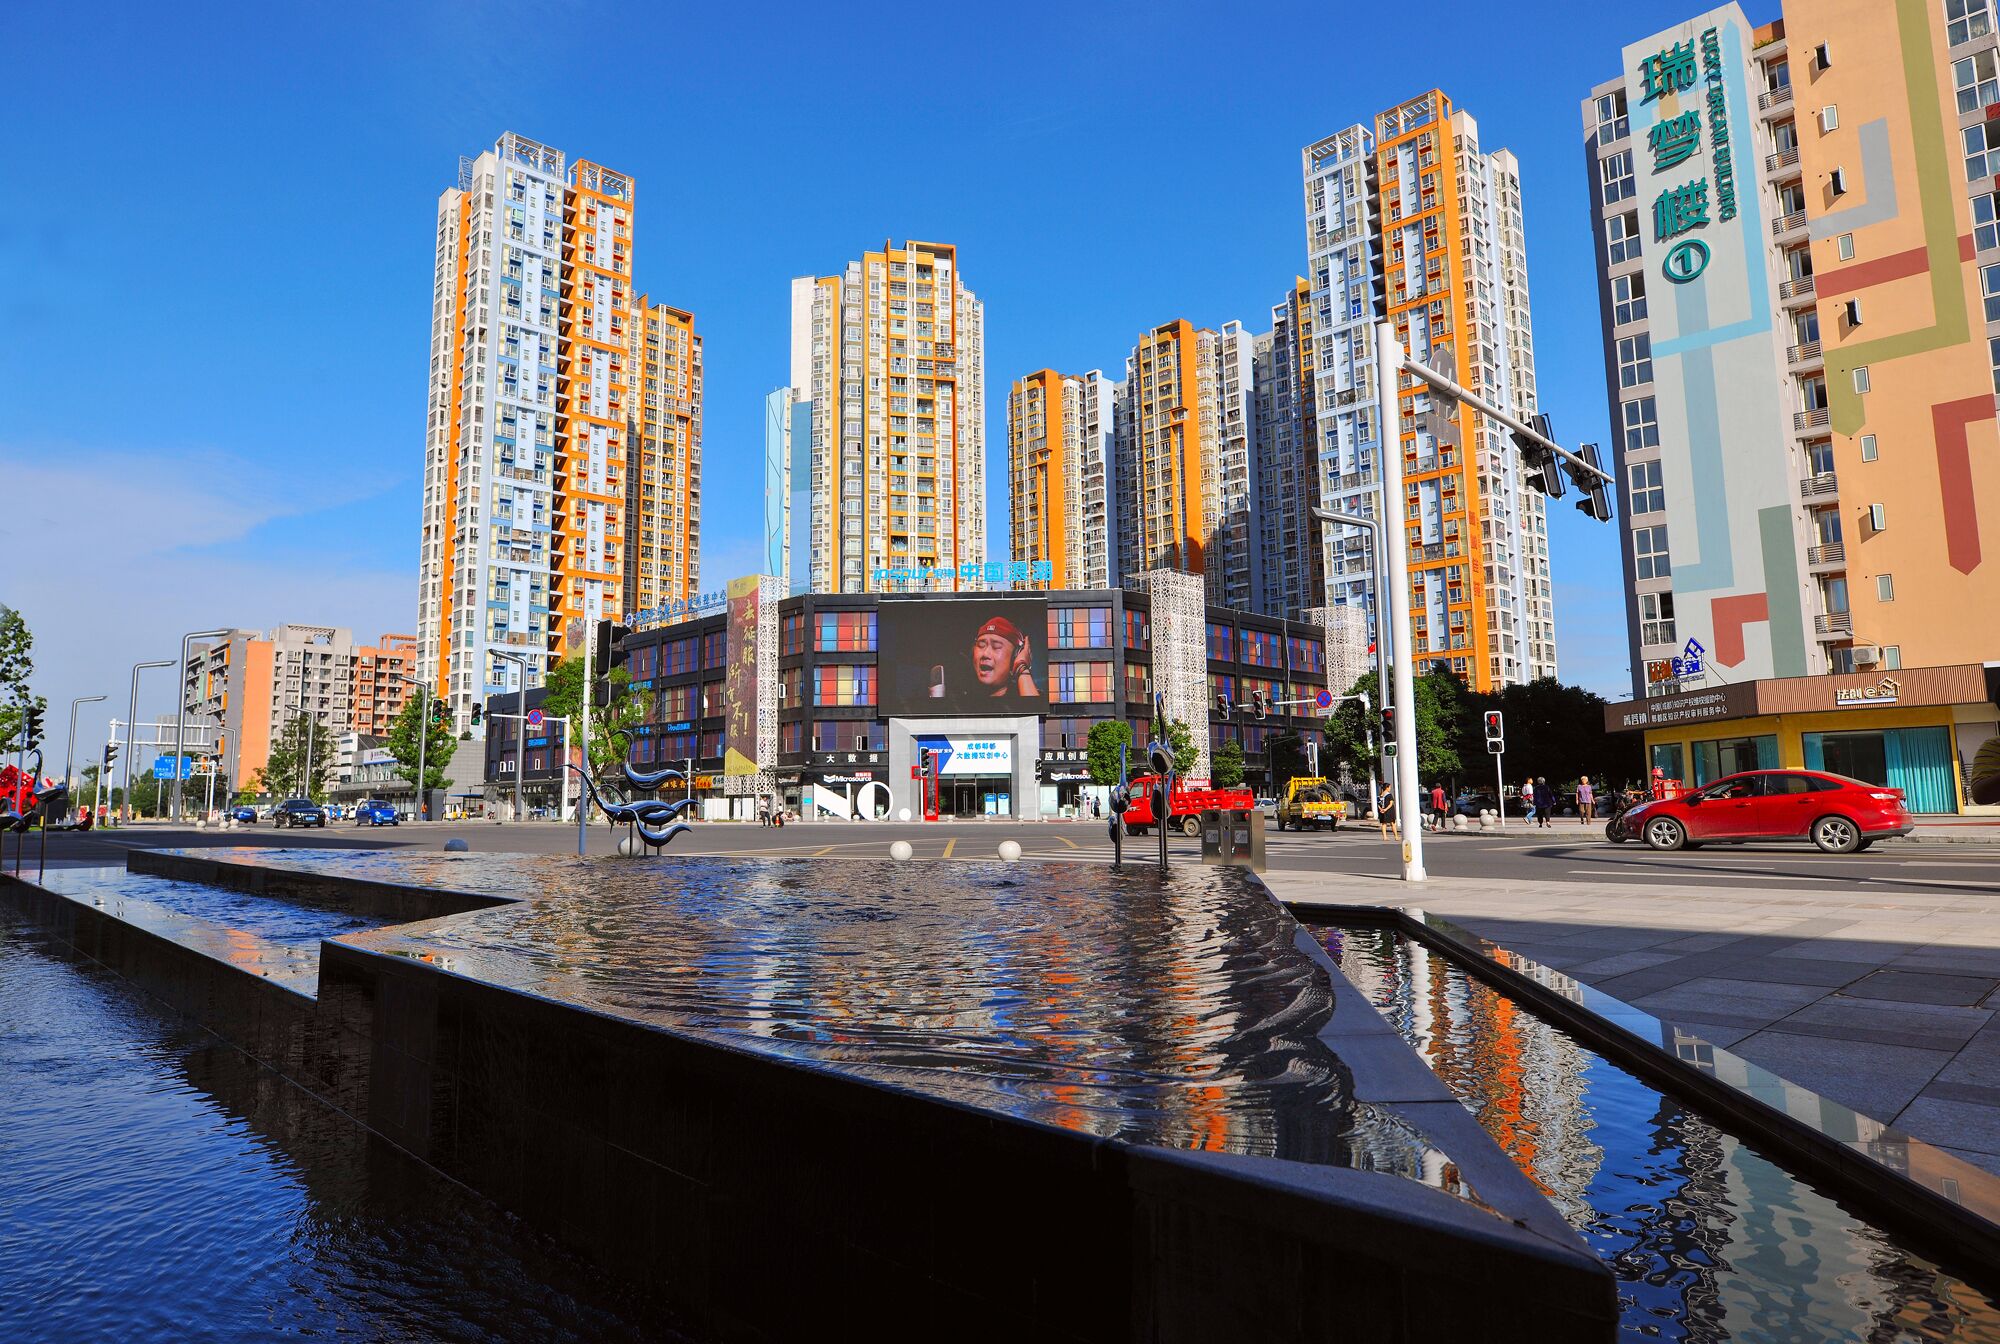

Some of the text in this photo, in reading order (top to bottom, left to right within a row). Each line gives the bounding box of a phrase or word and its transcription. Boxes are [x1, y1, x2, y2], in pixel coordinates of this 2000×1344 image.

[1702, 26, 1737, 220] LUCKY DREAM BUILDING
[873, 567, 934, 583] inspur
[959, 561, 1053, 582] 中国浪潮
[826, 753, 878, 763] 大数据
[956, 752, 1009, 760] 大数据双创中心
[1044, 751, 1088, 761] 应用创新
[835, 774, 872, 782] Microsource
